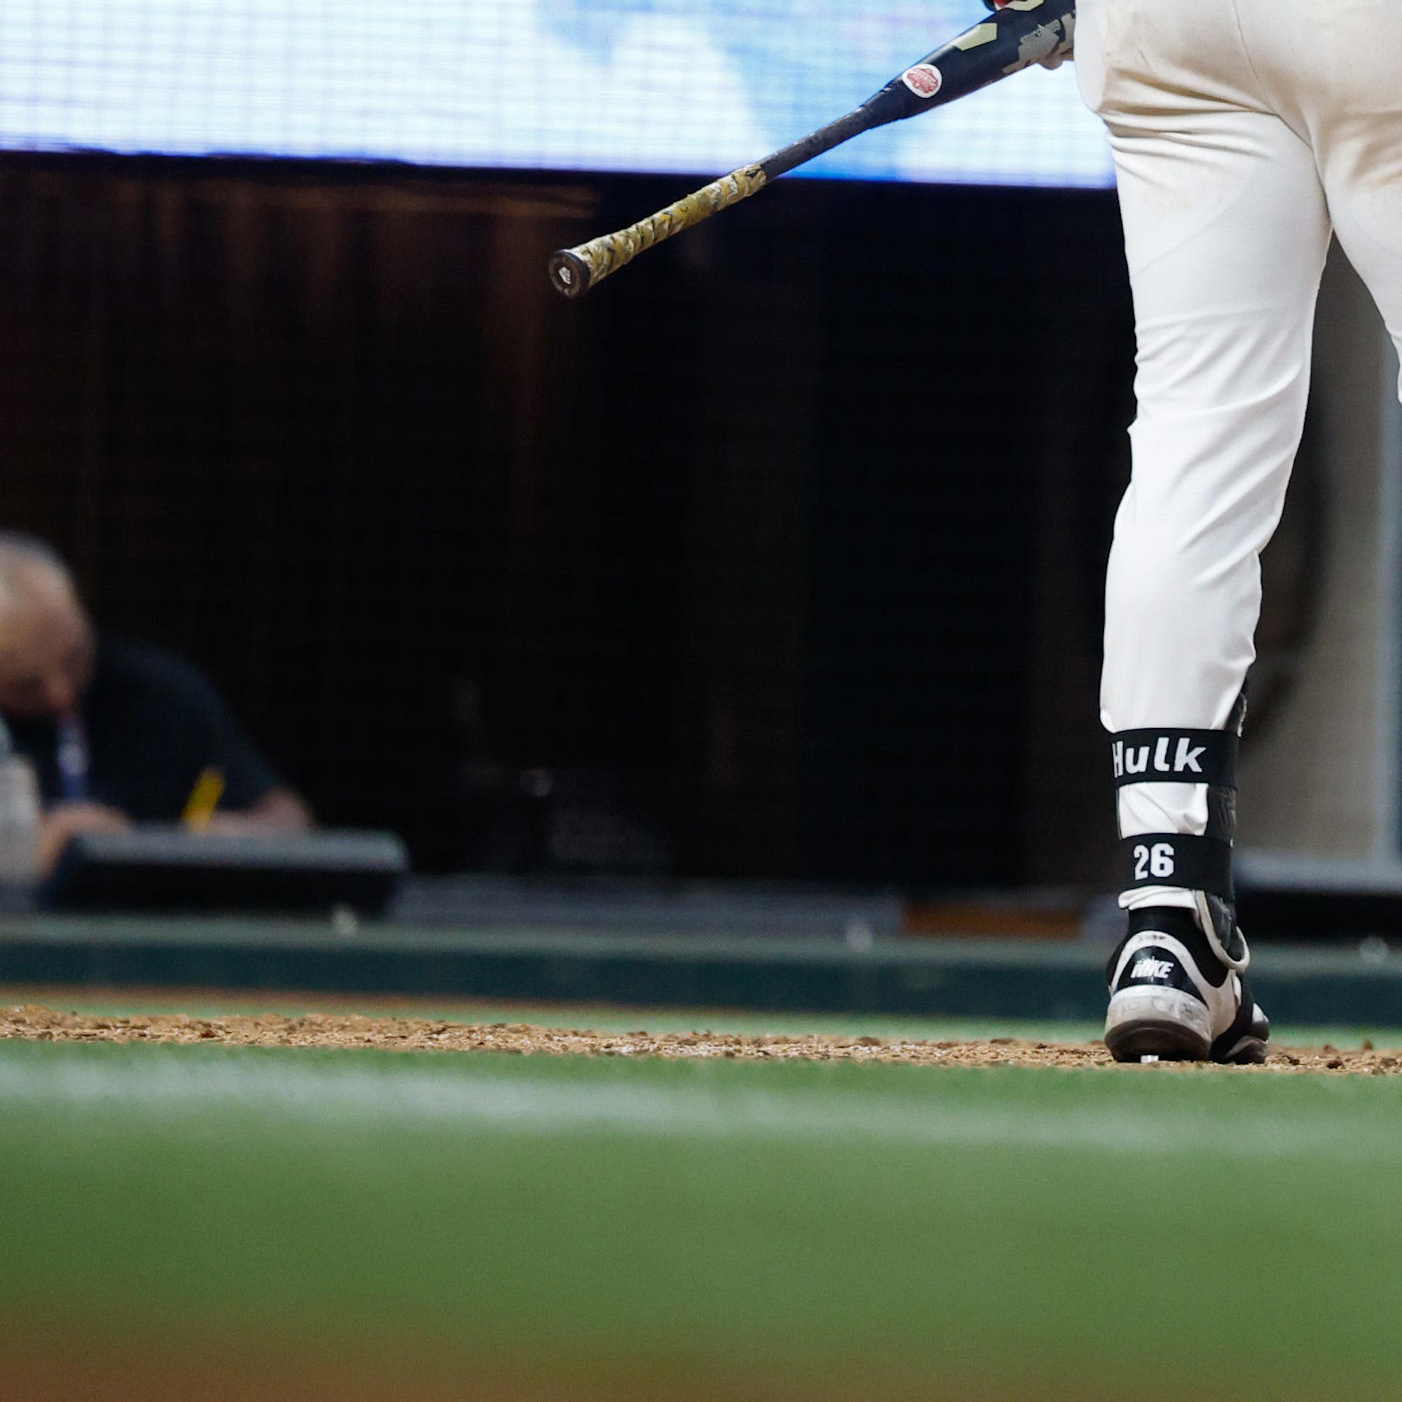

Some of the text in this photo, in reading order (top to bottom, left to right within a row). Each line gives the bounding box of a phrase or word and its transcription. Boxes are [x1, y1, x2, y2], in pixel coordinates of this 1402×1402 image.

[1111, 736, 1207, 779] Hulk
[1133, 843, 1176, 881] 26
[1130, 958, 1174, 980] NIKE
